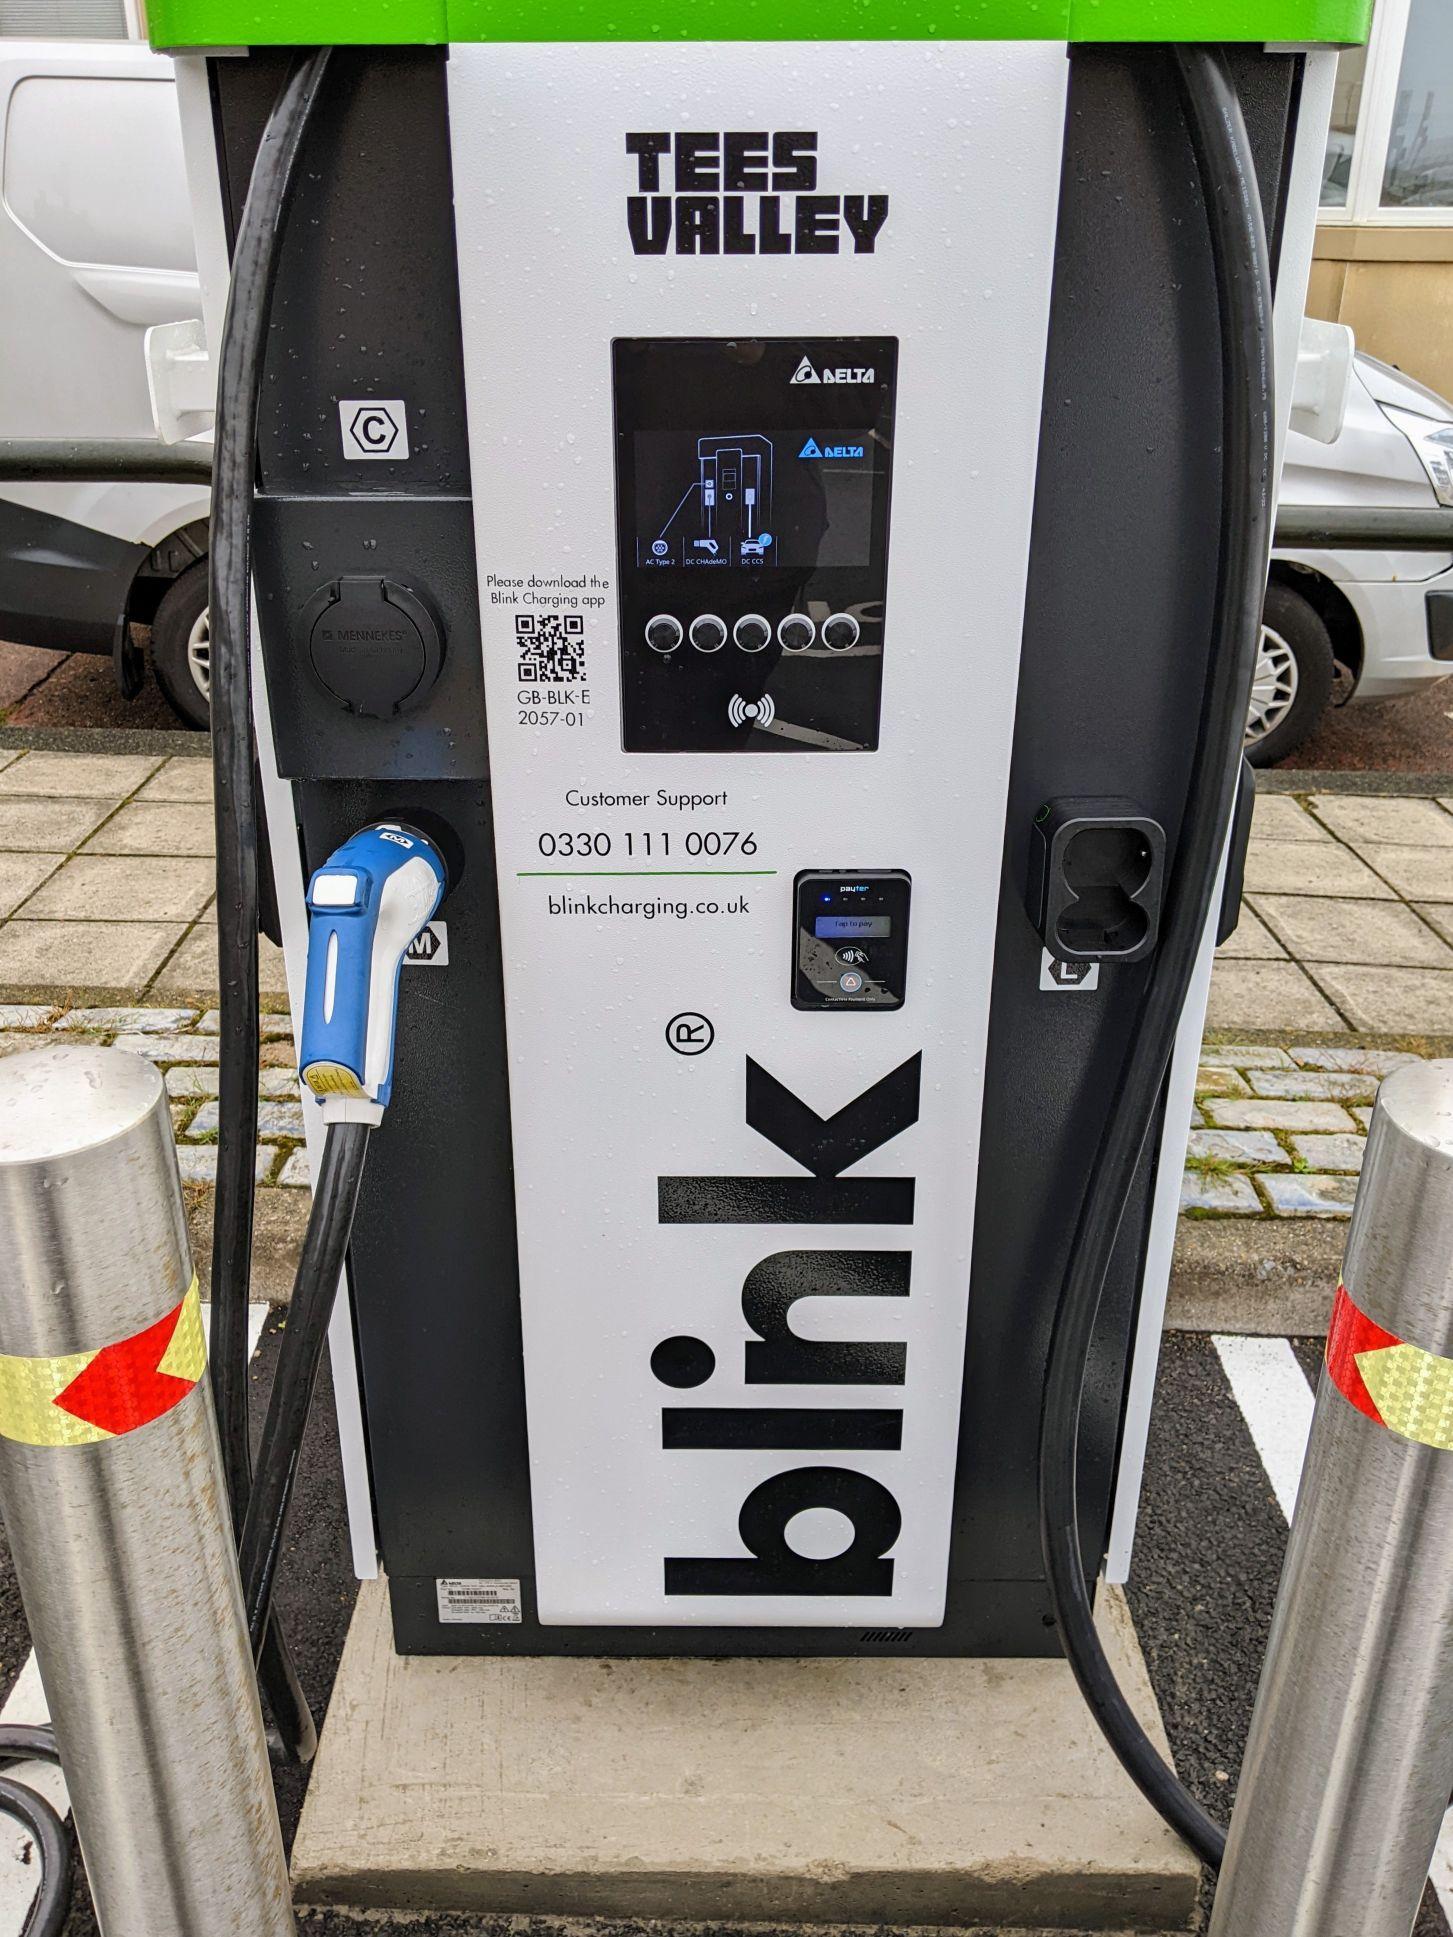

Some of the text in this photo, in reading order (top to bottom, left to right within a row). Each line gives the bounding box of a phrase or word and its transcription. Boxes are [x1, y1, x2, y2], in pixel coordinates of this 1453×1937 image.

[625, 131, 818, 193] TEES
[626, 194, 889, 256] VALLEY
[822, 367, 875, 384] DELTA
[362, 415, 386, 445] C
[824, 446, 864, 458] DELTA
[656, 559, 670, 567] Type
[486, 574, 610, 589] Please download the
[490, 591, 606, 609] Blink Charging app
[517, 690, 590, 705] GB-BLK-E
[518, 711, 583, 727] 2057-01
[565, 789, 727, 811] Customer Support
[538, 831, 758, 857] 0330 111 0076
[548, 894, 750, 919] blinkcharging.co.uk
[1061, 961, 1078, 979] L
[650, 1049, 923, 1597] blink
